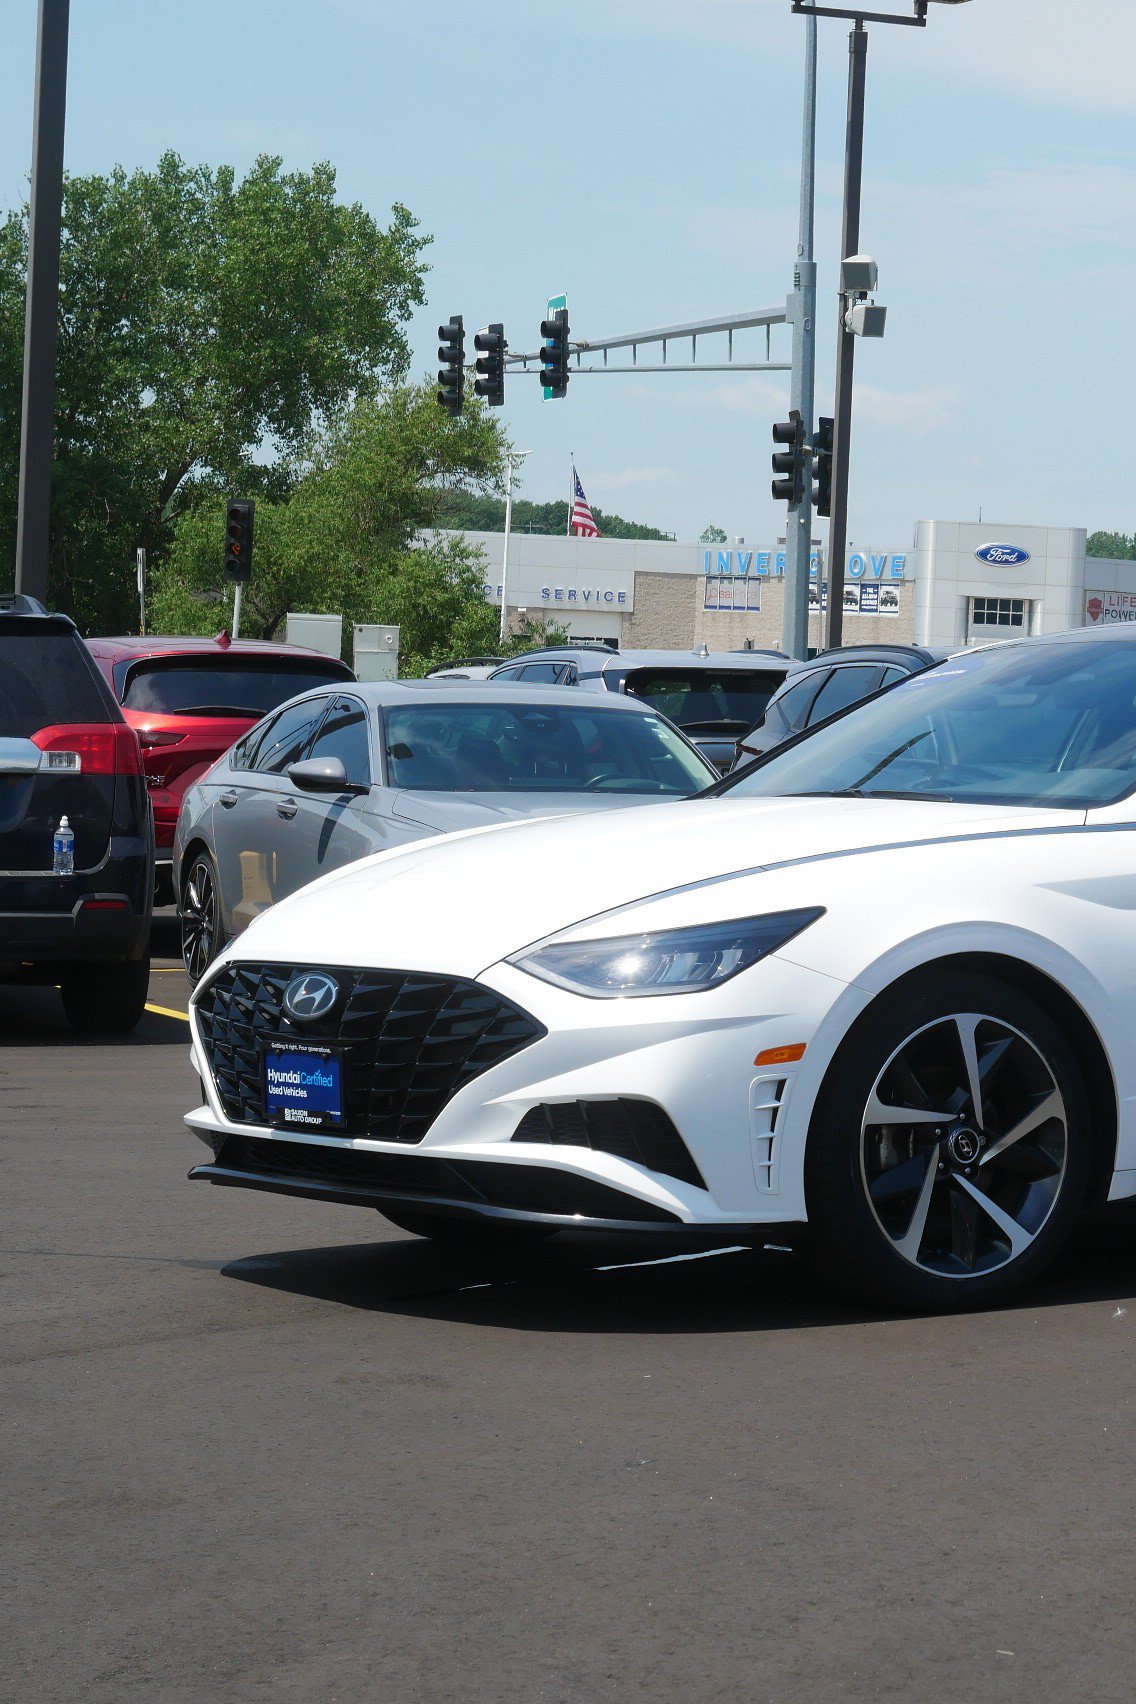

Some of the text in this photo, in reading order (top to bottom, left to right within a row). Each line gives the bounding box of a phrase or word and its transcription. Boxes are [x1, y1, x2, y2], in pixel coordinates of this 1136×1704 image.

[986, 547, 1019, 562] Ford
[704, 549, 906, 579] INVER GOVE
[541, 587, 626, 602] SERVICE
[267, 1069, 332, 1087] Hyundai Certified
[268, 1084, 307, 1097] Used Vehicles
[291, 1108, 308, 1117] SAXON
[291, 1114, 322, 1125] AUTO GROUP
